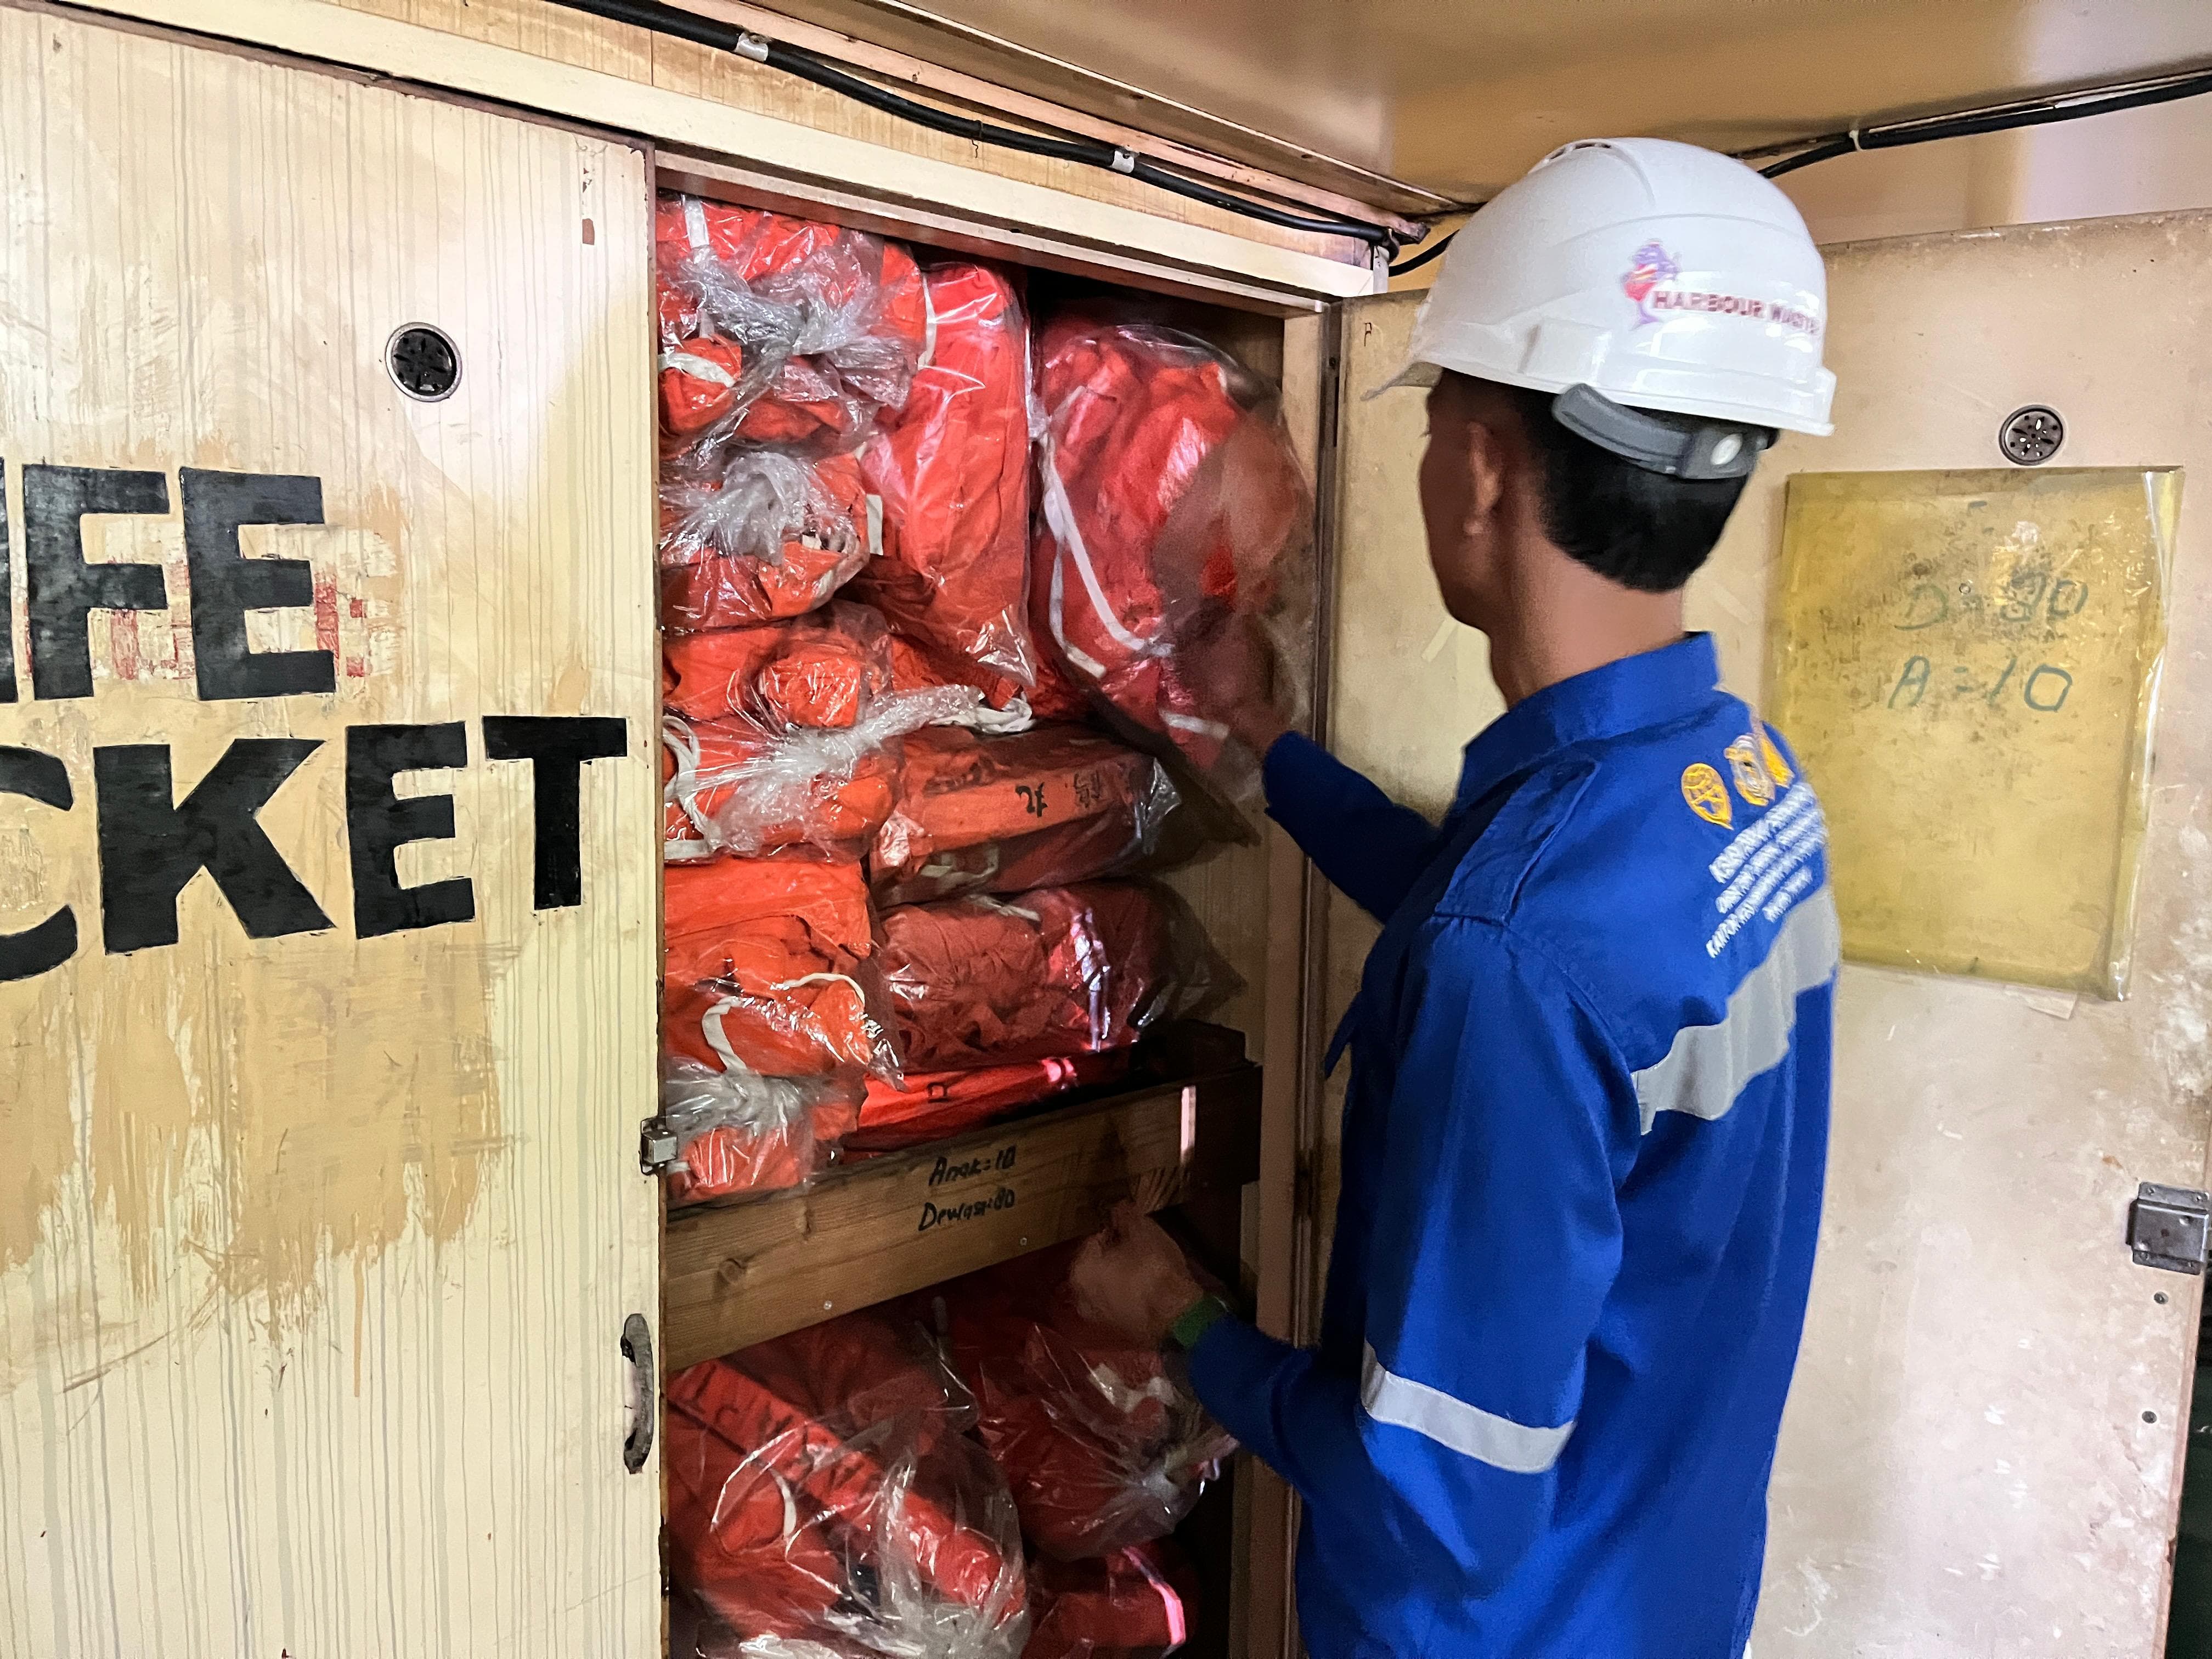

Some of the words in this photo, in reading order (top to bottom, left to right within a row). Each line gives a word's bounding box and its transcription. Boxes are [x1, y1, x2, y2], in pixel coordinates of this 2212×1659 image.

[1654, 290, 1766, 317] HARBOUR
[0, 456, 336, 702] FE
[0, 715, 628, 982] CKET
